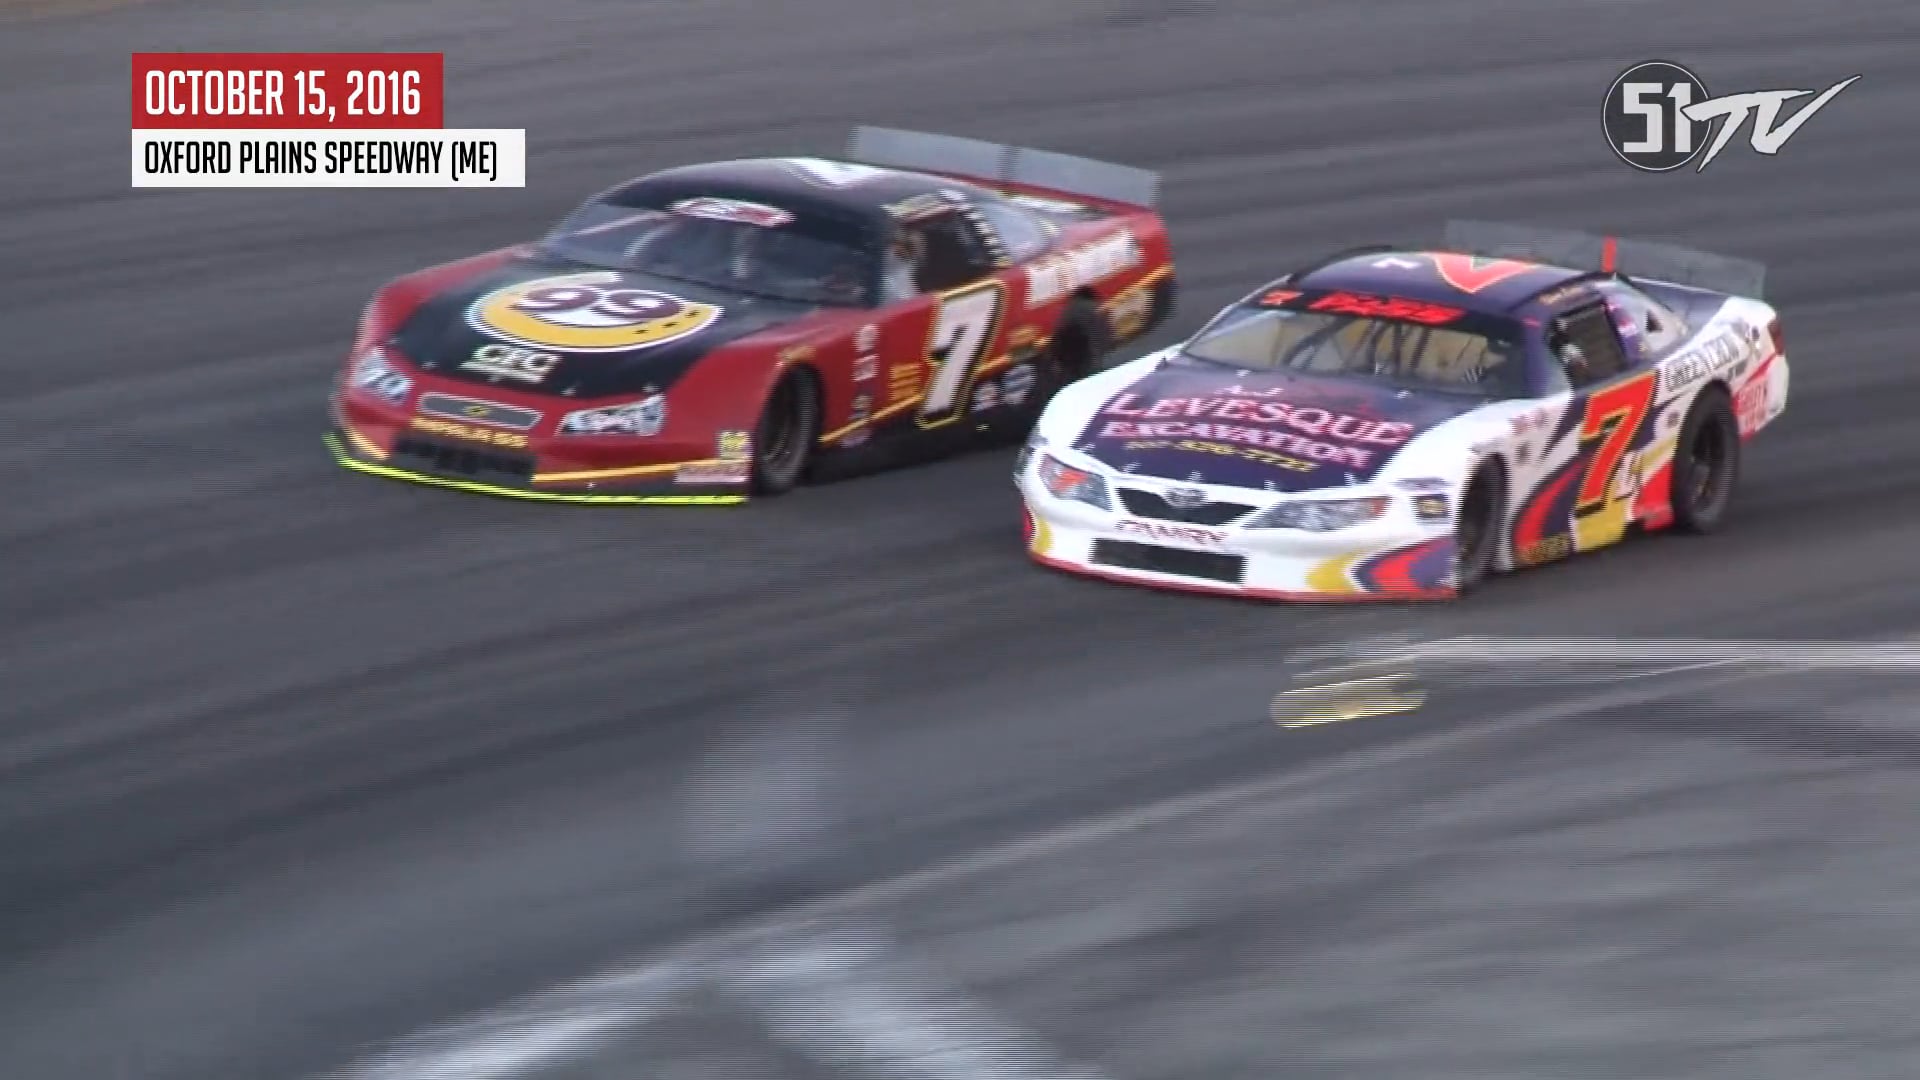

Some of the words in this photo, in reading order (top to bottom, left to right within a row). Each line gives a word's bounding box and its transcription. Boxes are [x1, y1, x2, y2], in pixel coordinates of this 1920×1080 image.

[508, 285, 686, 320] 99
[919, 281, 1004, 427] 7
[1100, 421, 1373, 468] EXCAVATION
[1102, 393, 1413, 446] LEVESQUE
[1574, 371, 1660, 518] 7
[1115, 520, 1228, 545] CAMRY
